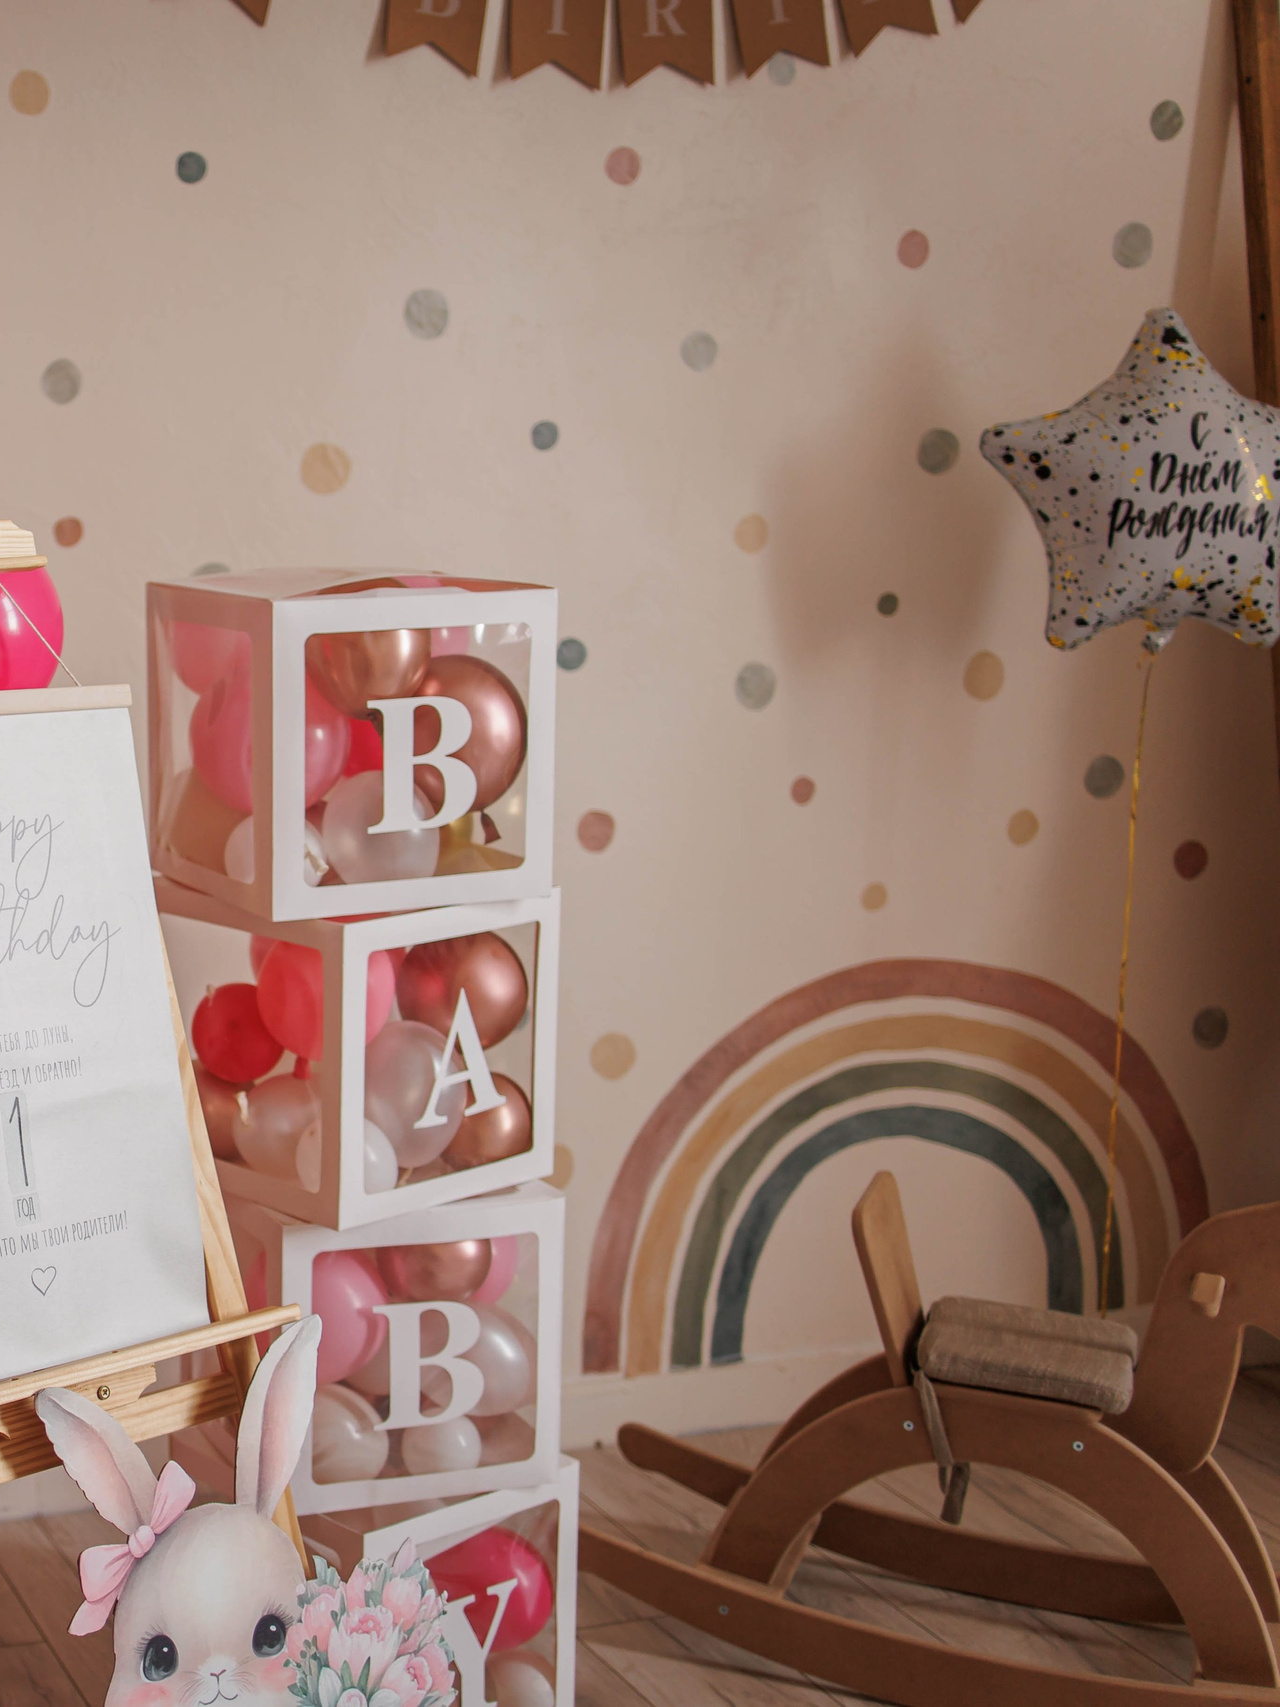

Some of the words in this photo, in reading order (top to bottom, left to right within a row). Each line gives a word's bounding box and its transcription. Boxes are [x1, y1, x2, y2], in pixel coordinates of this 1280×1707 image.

[24, 1029, 39, 1051] ДО
[22, 1066, 32, 1085] И
[34, 1056, 83, 1084] ОБРАТНО!
[9, 1096, 29, 1187] 1
[16, 1196, 37, 1221] ГОД
[20, 1231, 40, 1253] МЫ
[71, 1209, 128, 1243] РОДИТЕЛИ!
